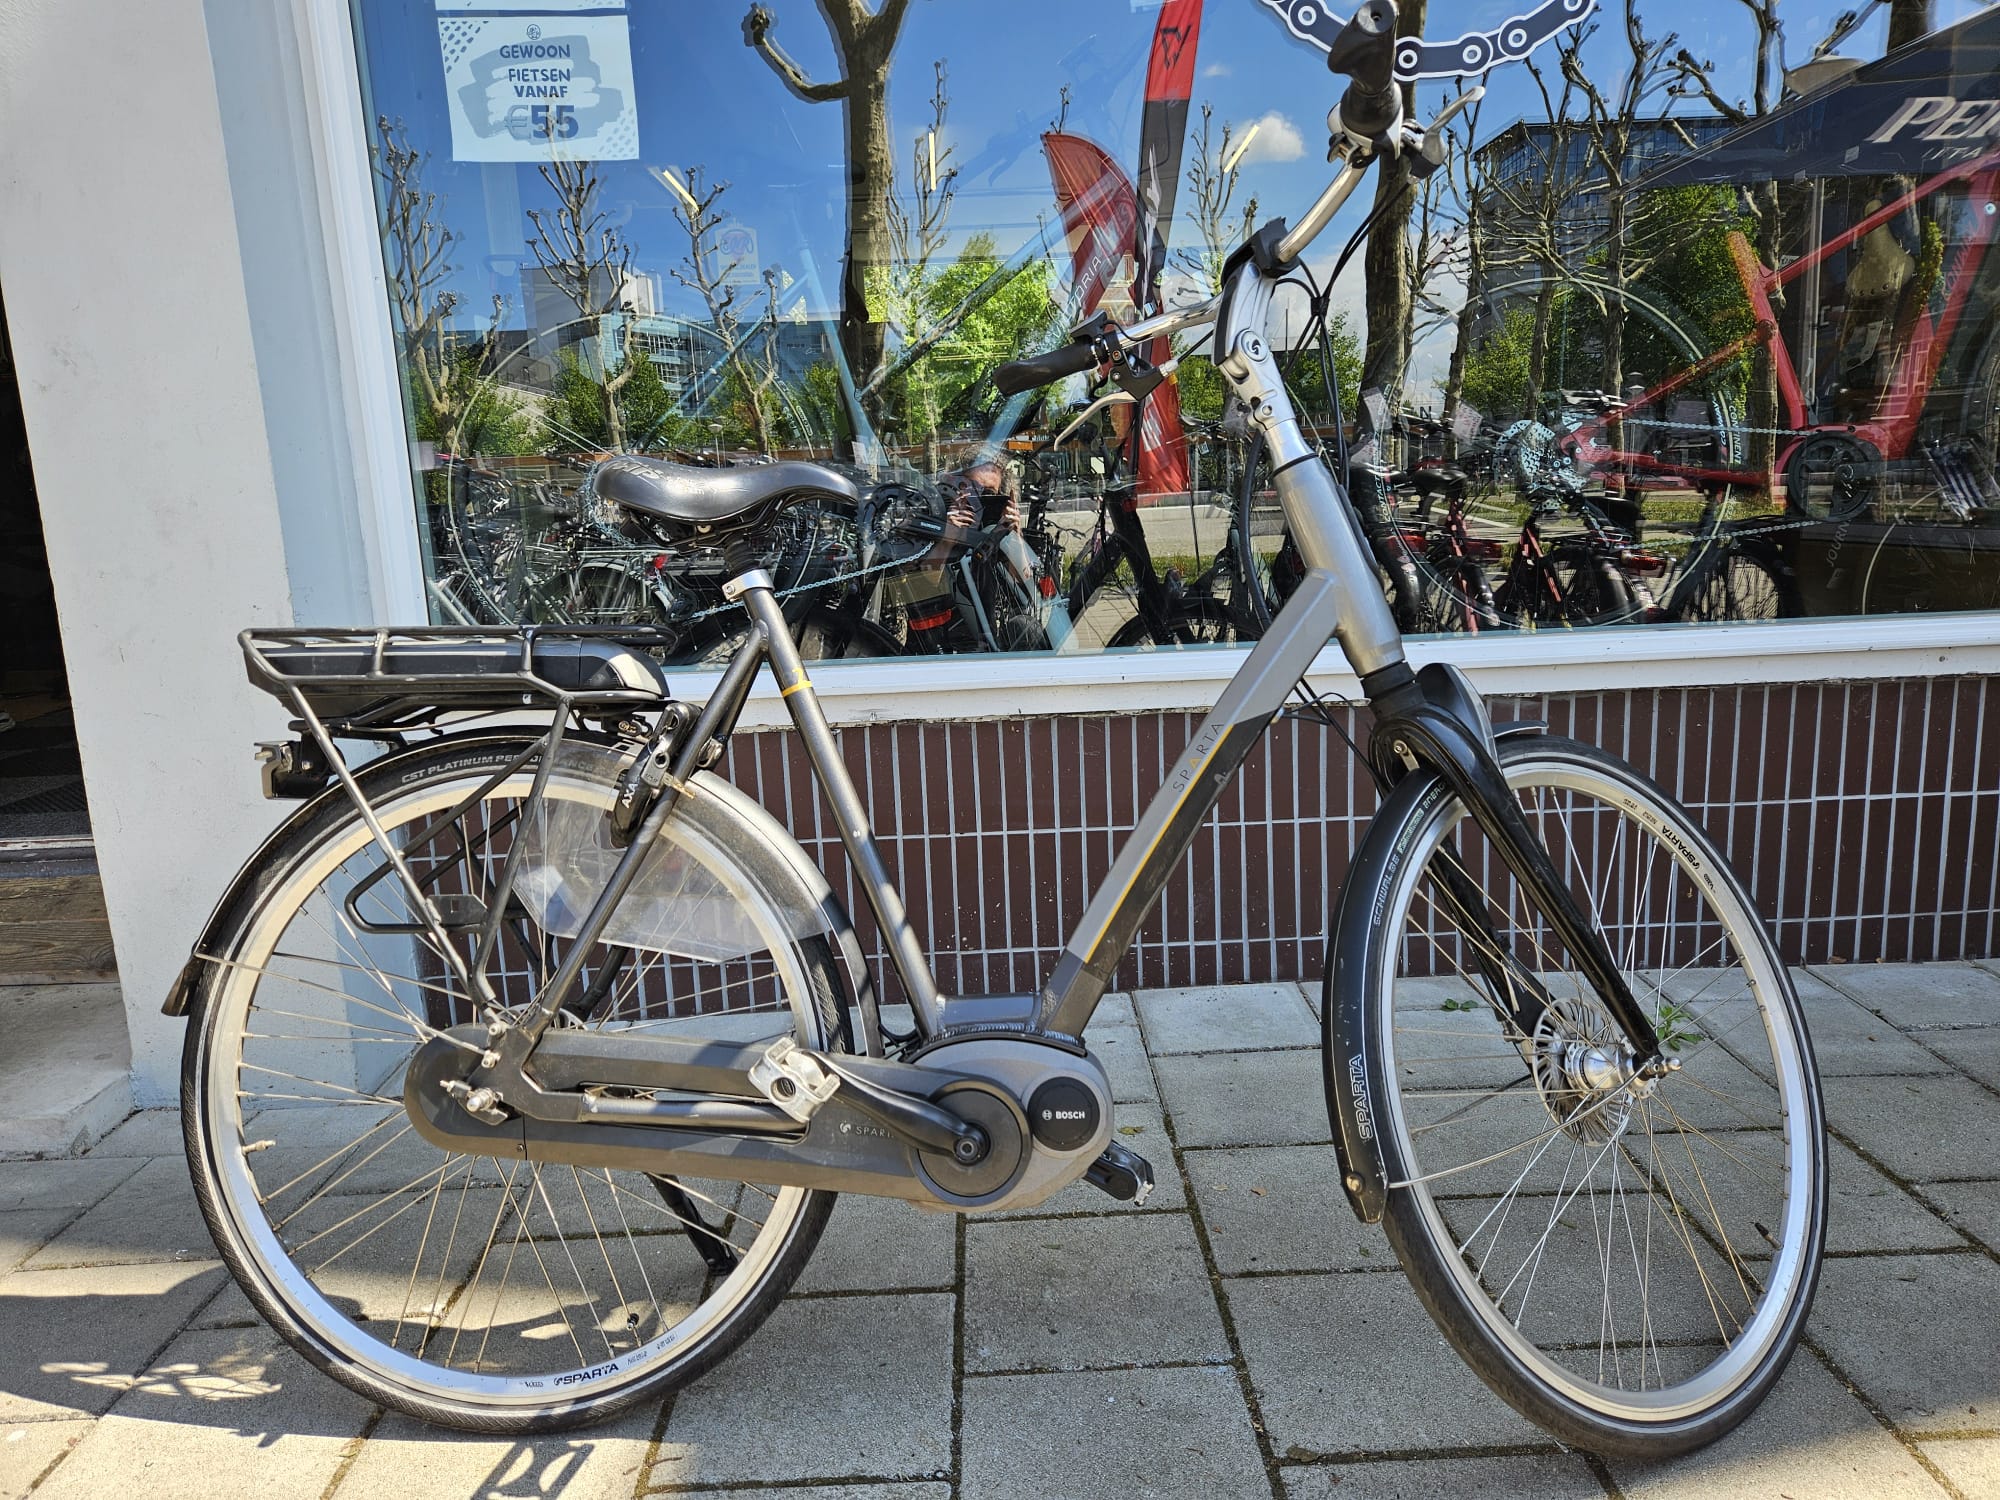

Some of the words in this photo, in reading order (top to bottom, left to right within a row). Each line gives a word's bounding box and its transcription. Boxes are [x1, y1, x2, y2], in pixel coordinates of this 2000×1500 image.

[500, 44, 571, 59] GEWOON
[508, 68, 571, 82] FIETSEN
[514, 85, 568, 98] VANAF
[504, 105, 579, 139] €55
[401, 769, 426, 784] CST
[427, 755, 493, 775] PLATINUM
[1173, 724, 1224, 792] SPARTA
[622, 783, 638, 808] AXA
[1661, 825, 1696, 865] SPARTA
[1349, 1053, 1373, 1140] SPARTA
[1055, 1110, 1085, 1120] BOSCH
[856, 1126, 895, 1139] SPAR
[562, 1363, 619, 1385] SPARTA
